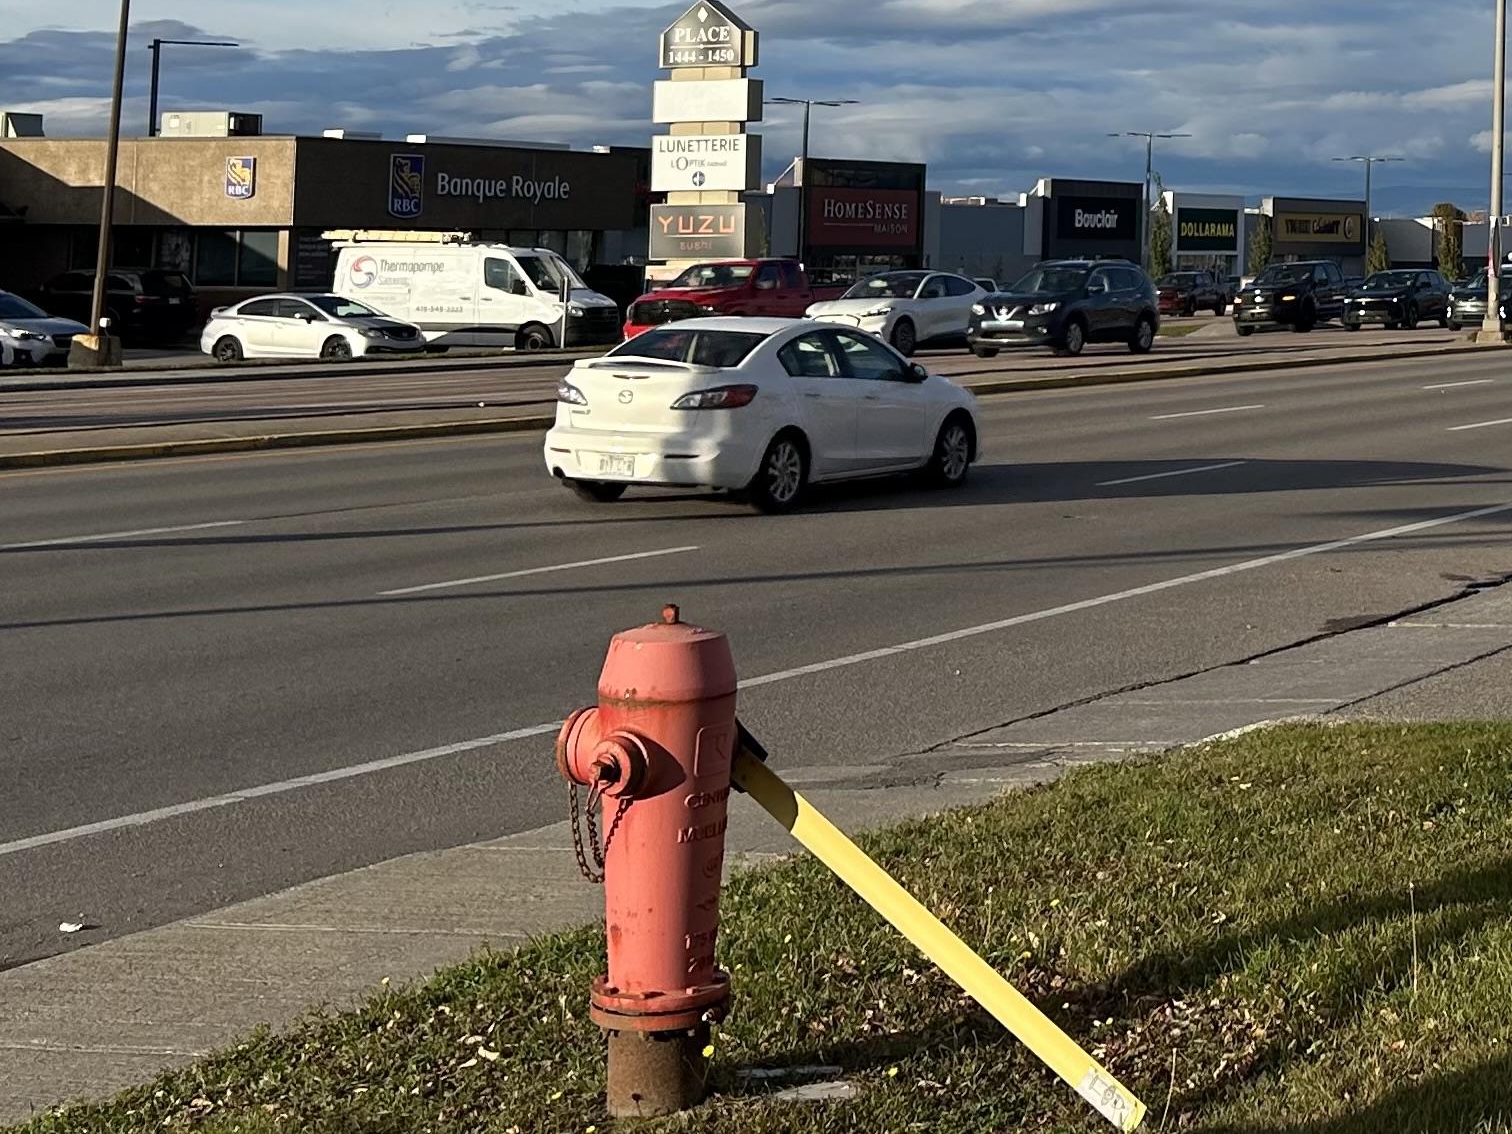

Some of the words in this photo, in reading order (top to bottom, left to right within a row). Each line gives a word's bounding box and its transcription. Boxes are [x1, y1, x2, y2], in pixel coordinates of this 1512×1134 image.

[673, 26, 731, 43] PLACE
[668, 51, 697, 64] 1444
[707, 49, 735, 62] 1450
[659, 138, 741, 153] LUNETTERIE
[227, 185, 250, 196] RBC
[437, 172, 507, 203] Banque
[511, 175, 570, 204] Royale
[393, 198, 420, 213] RBC
[658, 214, 736, 234] YUZU
[1074, 208, 1119, 228] Bouclair
[1180, 222, 1235, 237] DOLLARAMA
